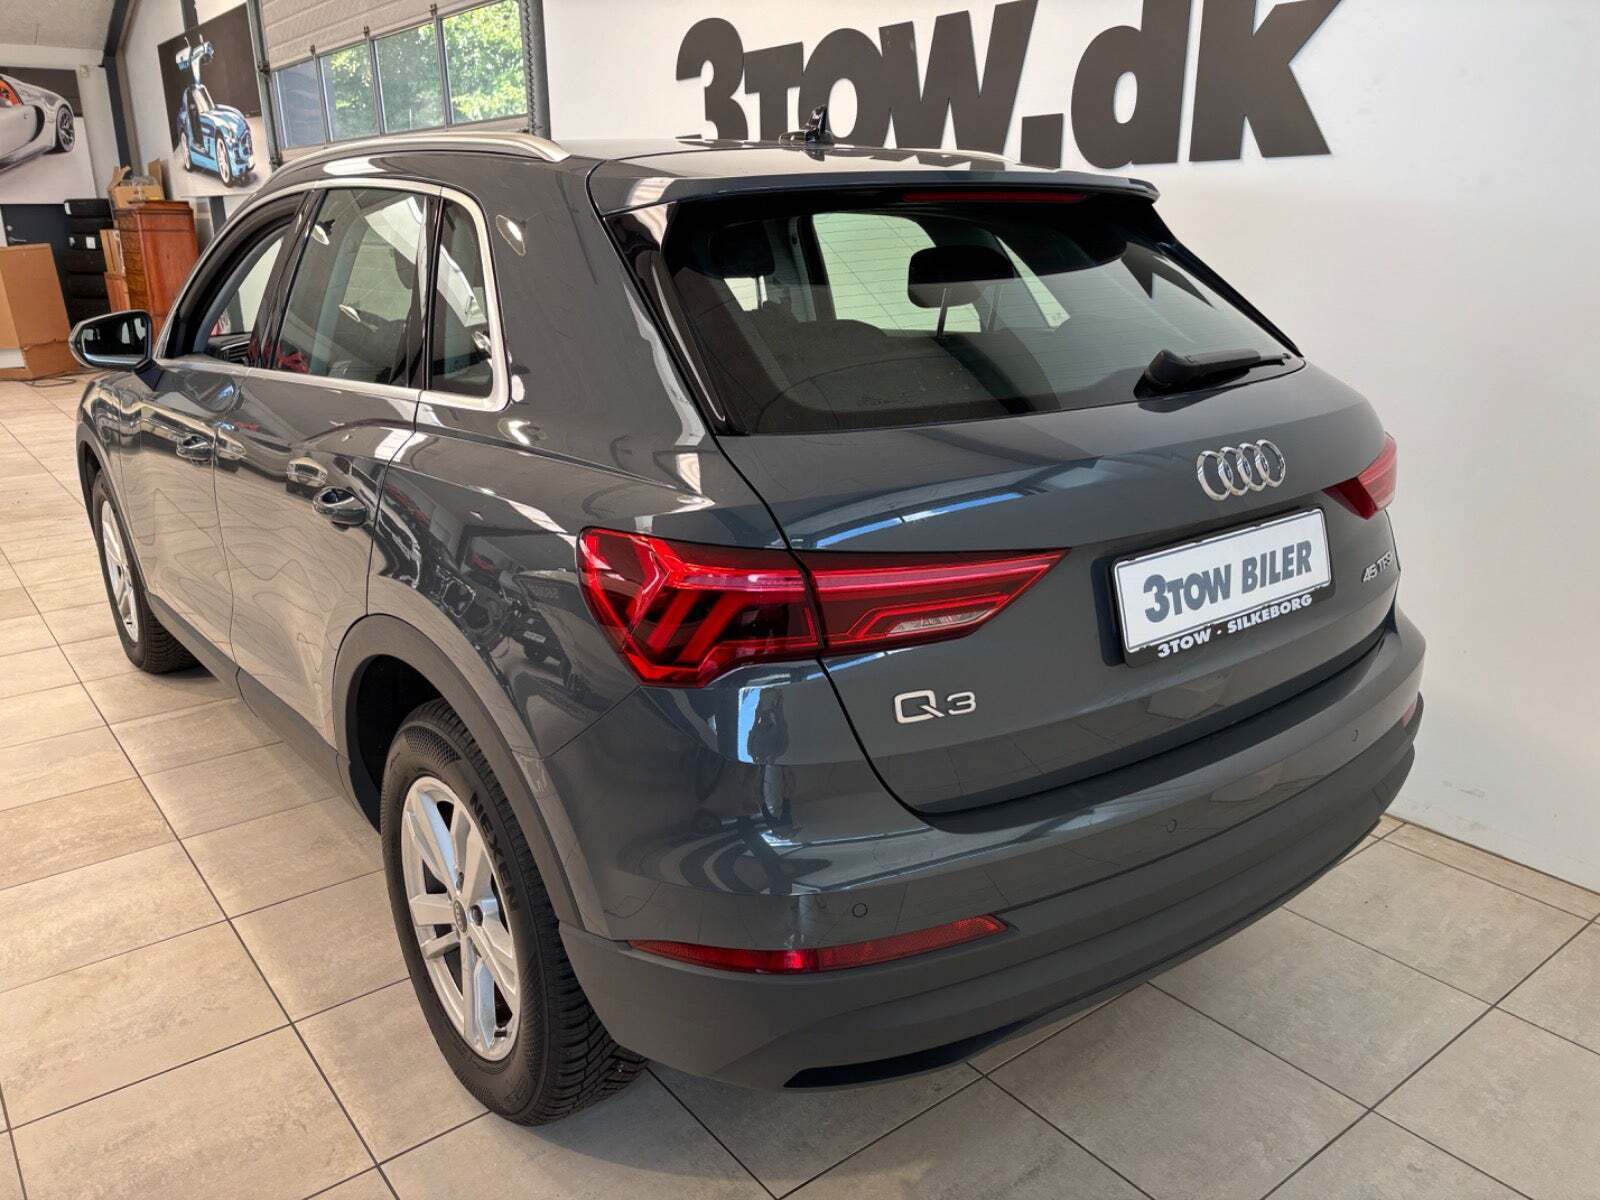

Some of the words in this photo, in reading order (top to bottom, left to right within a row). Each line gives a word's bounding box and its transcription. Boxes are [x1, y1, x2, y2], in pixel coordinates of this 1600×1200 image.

[677, 0, 1342, 169] 3TOW.dk
[1143, 564, 1232, 624] 3TOW
[1242, 540, 1313, 594] BILER
[1363, 563, 1377, 582] 45
[1157, 627, 1212, 658] 3TOW
[1227, 594, 1313, 634] SILKEBORG
[894, 689, 977, 724] Q3
[469, 791, 520, 911] NEXEN
